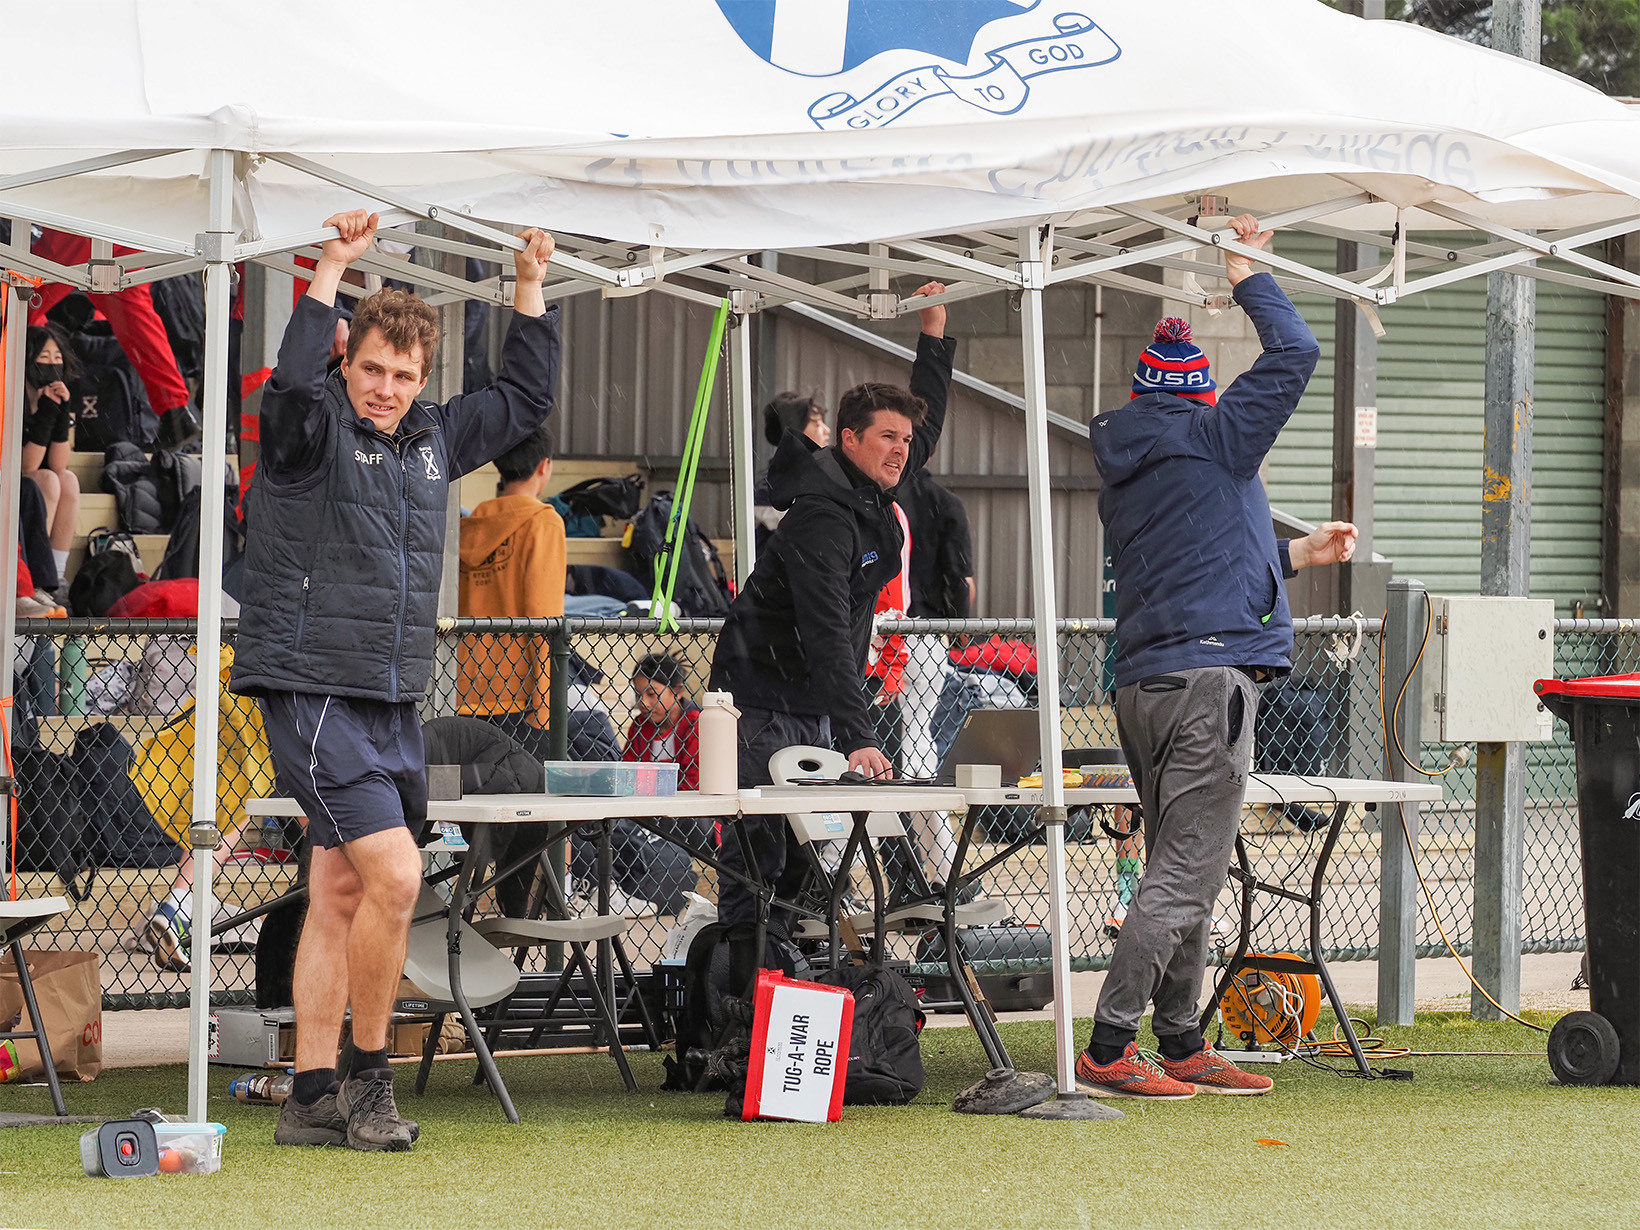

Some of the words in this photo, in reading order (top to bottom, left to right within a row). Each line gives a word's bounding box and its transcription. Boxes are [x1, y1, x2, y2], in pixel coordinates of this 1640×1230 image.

[846, 77, 927, 129] GLORY
[974, 85, 1005, 102] TO
[1028, 43, 1084, 65] GOD
[1145, 367, 1203, 385] USA
[354, 450, 383, 465] STAFF
[783, 1014, 810, 1093] TUG-A-WAR
[813, 1039, 834, 1076] ROPE
